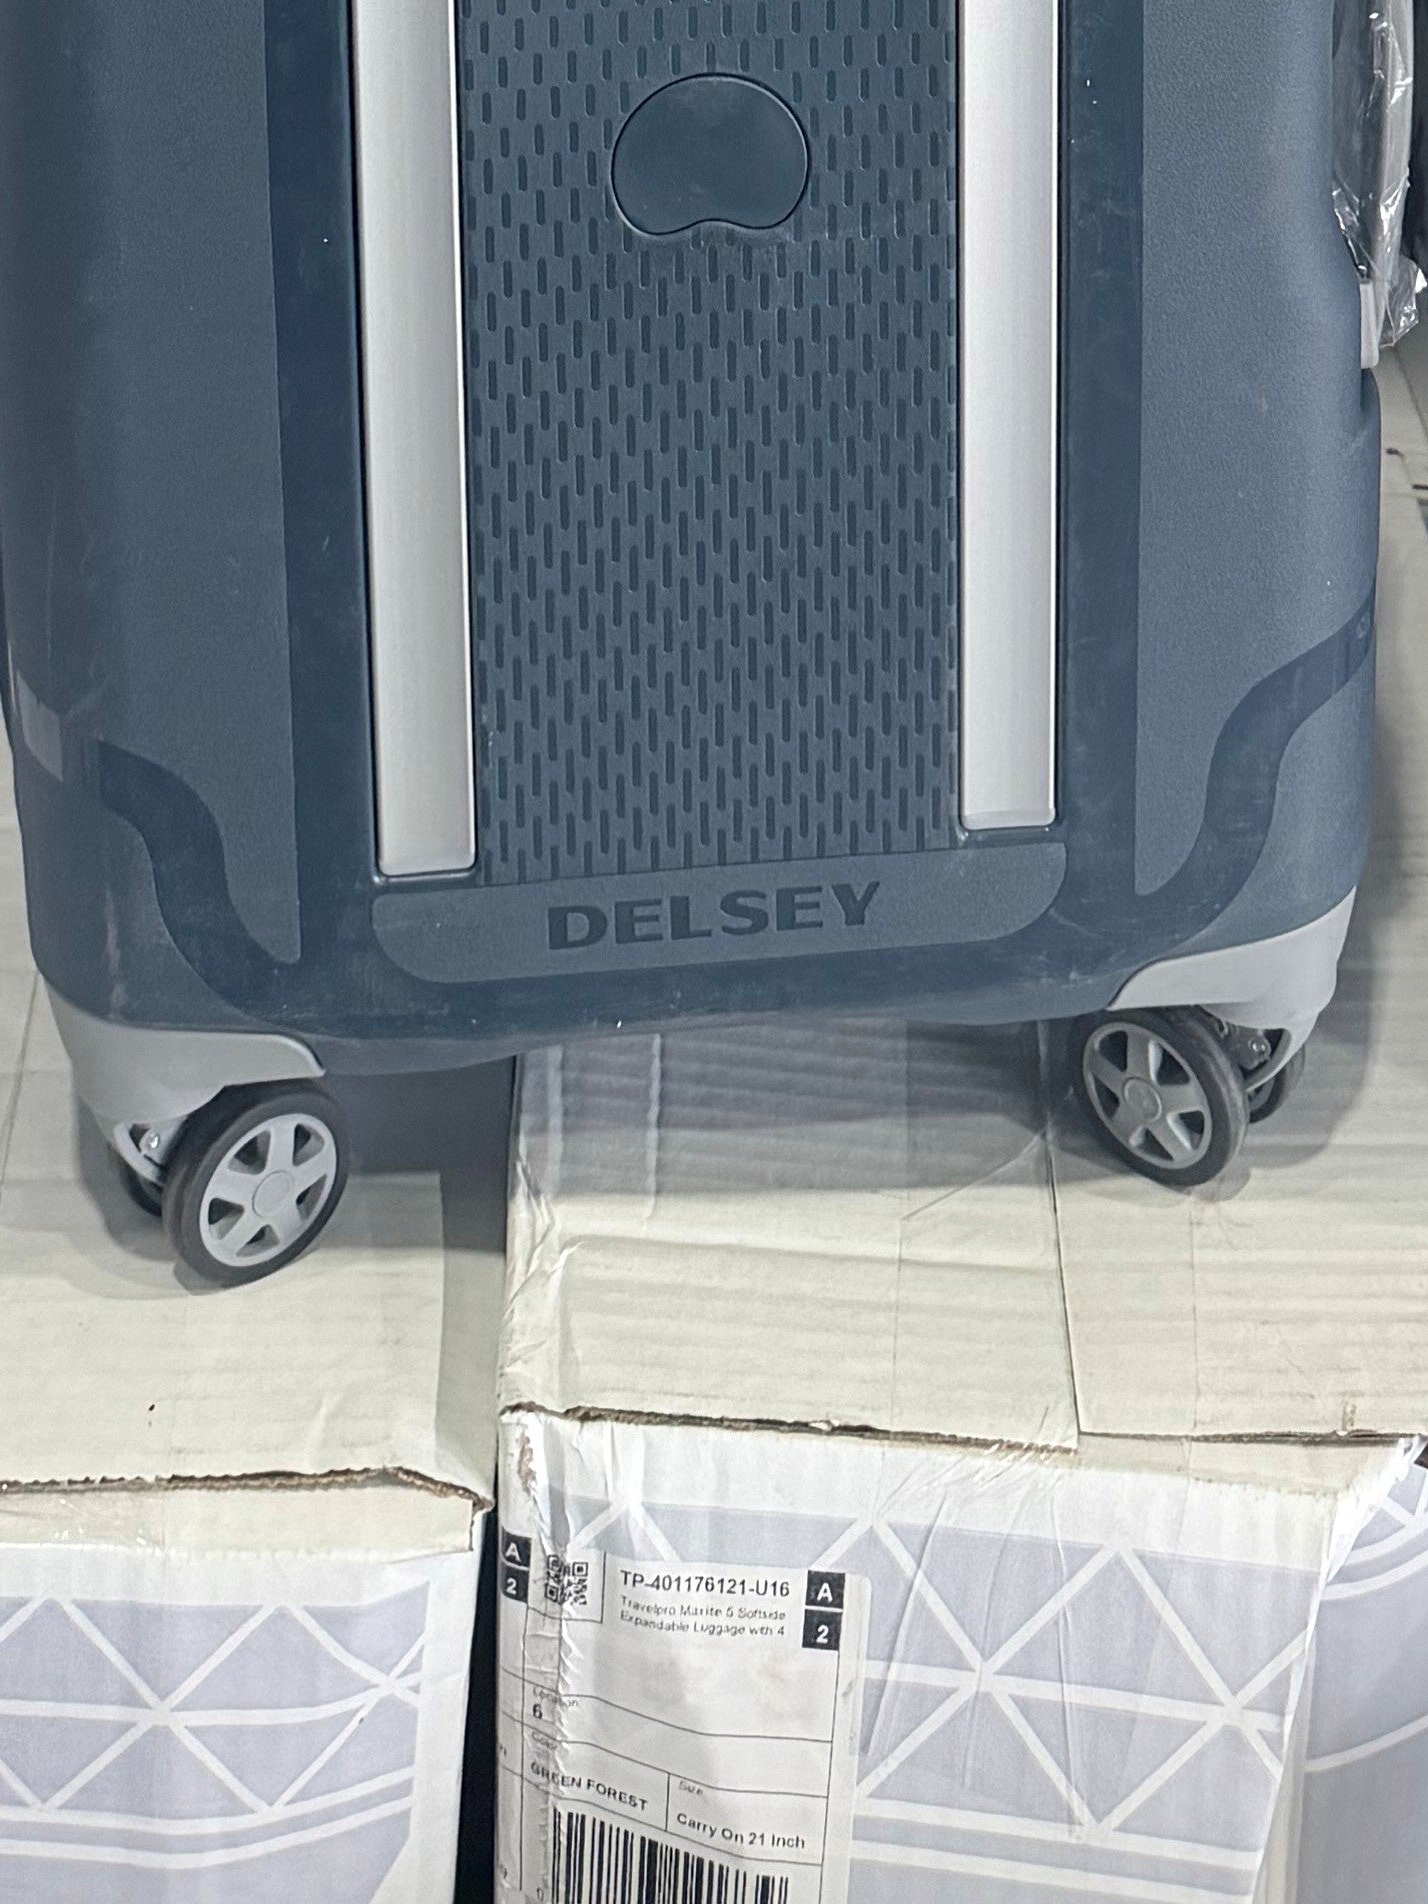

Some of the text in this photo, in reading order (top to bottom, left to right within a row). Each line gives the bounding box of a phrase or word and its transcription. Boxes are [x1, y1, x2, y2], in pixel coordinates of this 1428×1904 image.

[547, 880, 880, 950] DELSEY
[505, 1542, 521, 1559] A
[504, 1578, 517, 1595] 2
[620, 1569, 790, 1598] TP-401176121-U16
[816, 1582, 833, 1601] A
[621, 1595, 676, 1617] Travelpro
[620, 1610, 690, 1632] Expandable
[693, 1622, 746, 1637] Luggage
[777, 1626, 785, 1636] 4
[815, 1624, 829, 1643] 2
[532, 1703, 543, 1719] 6
[530, 1761, 649, 1812] GREEN FOREST
[676, 1812, 805, 1850] Carry On 21 Inch
